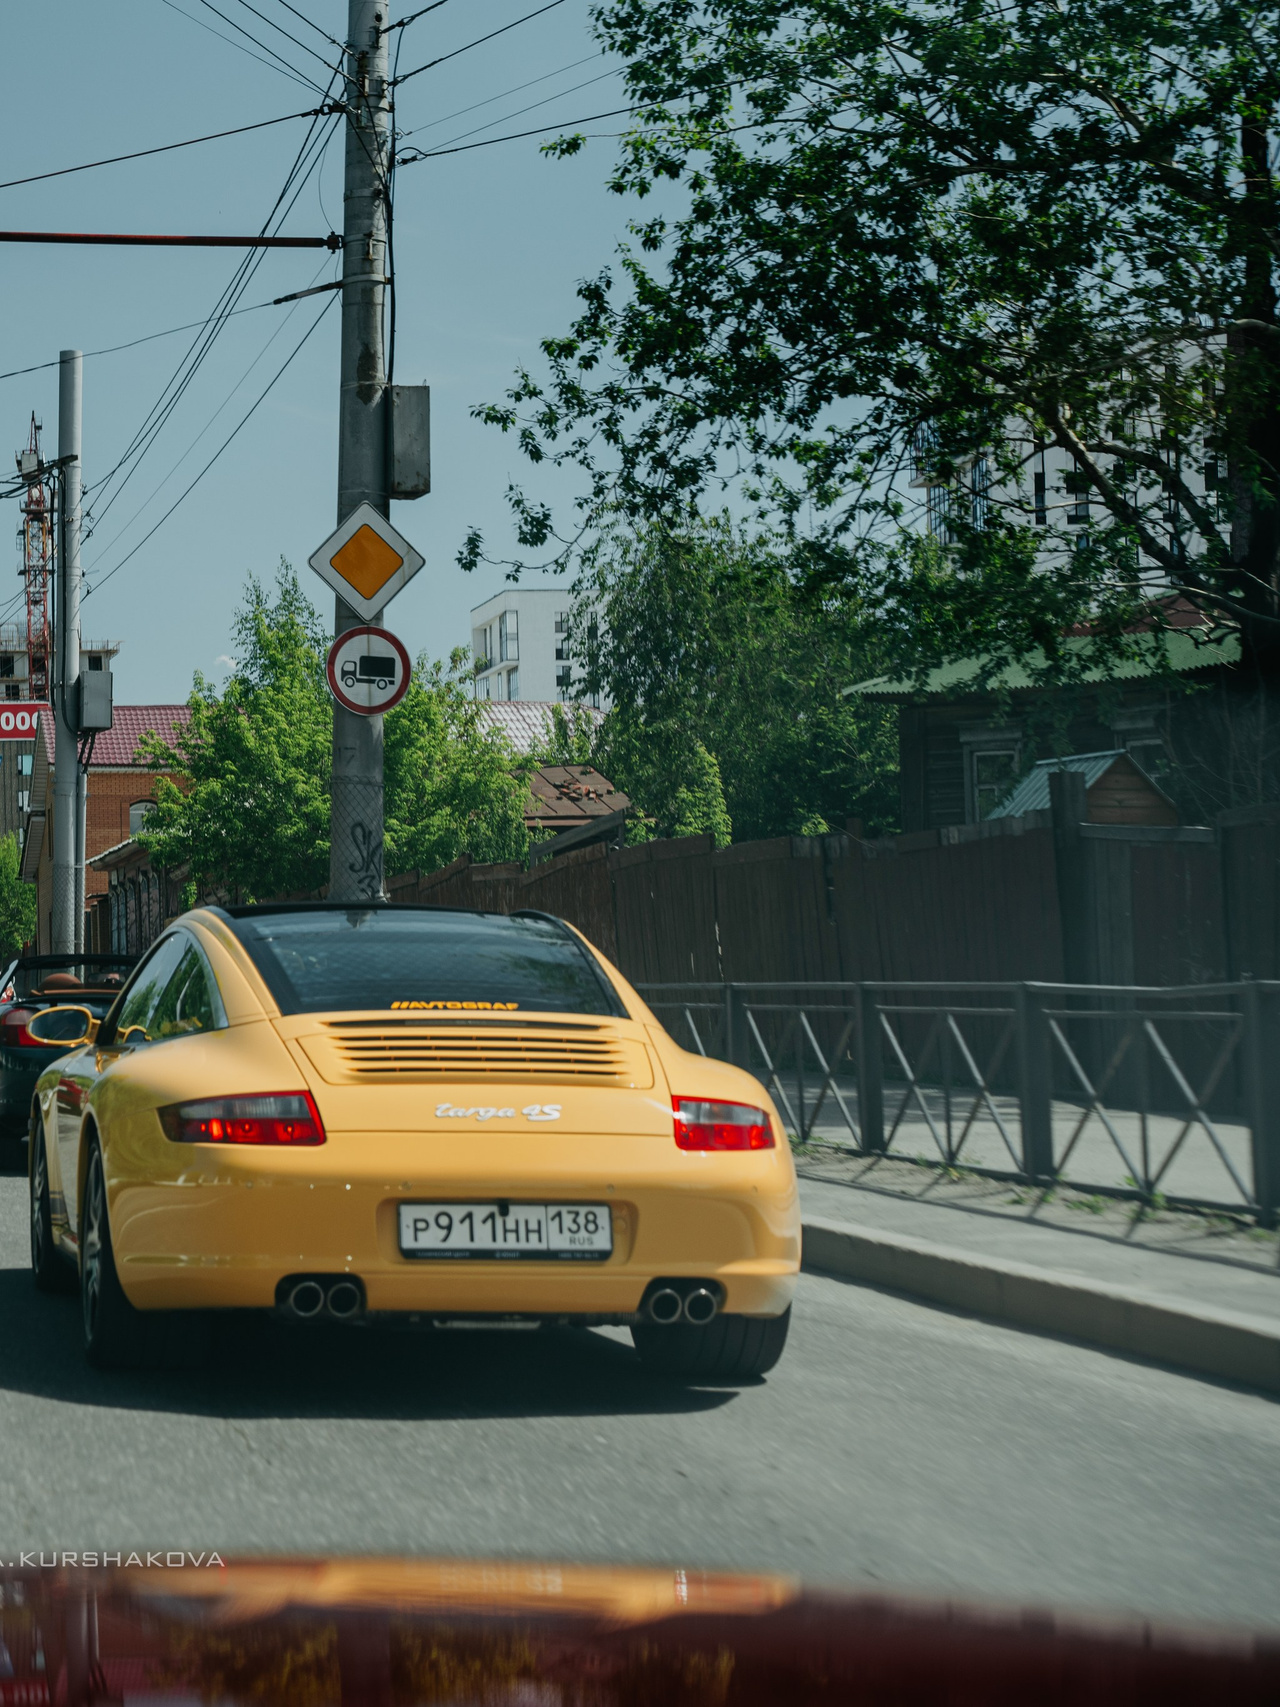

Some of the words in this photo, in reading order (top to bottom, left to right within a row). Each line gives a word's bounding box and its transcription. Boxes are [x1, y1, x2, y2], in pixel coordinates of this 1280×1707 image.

[522, 1104, 562, 1122] 4S
[413, 1210, 543, 1243] Р911НН
[550, 1210, 599, 1235] 138
[569, 1236, 594, 1246] RUS
